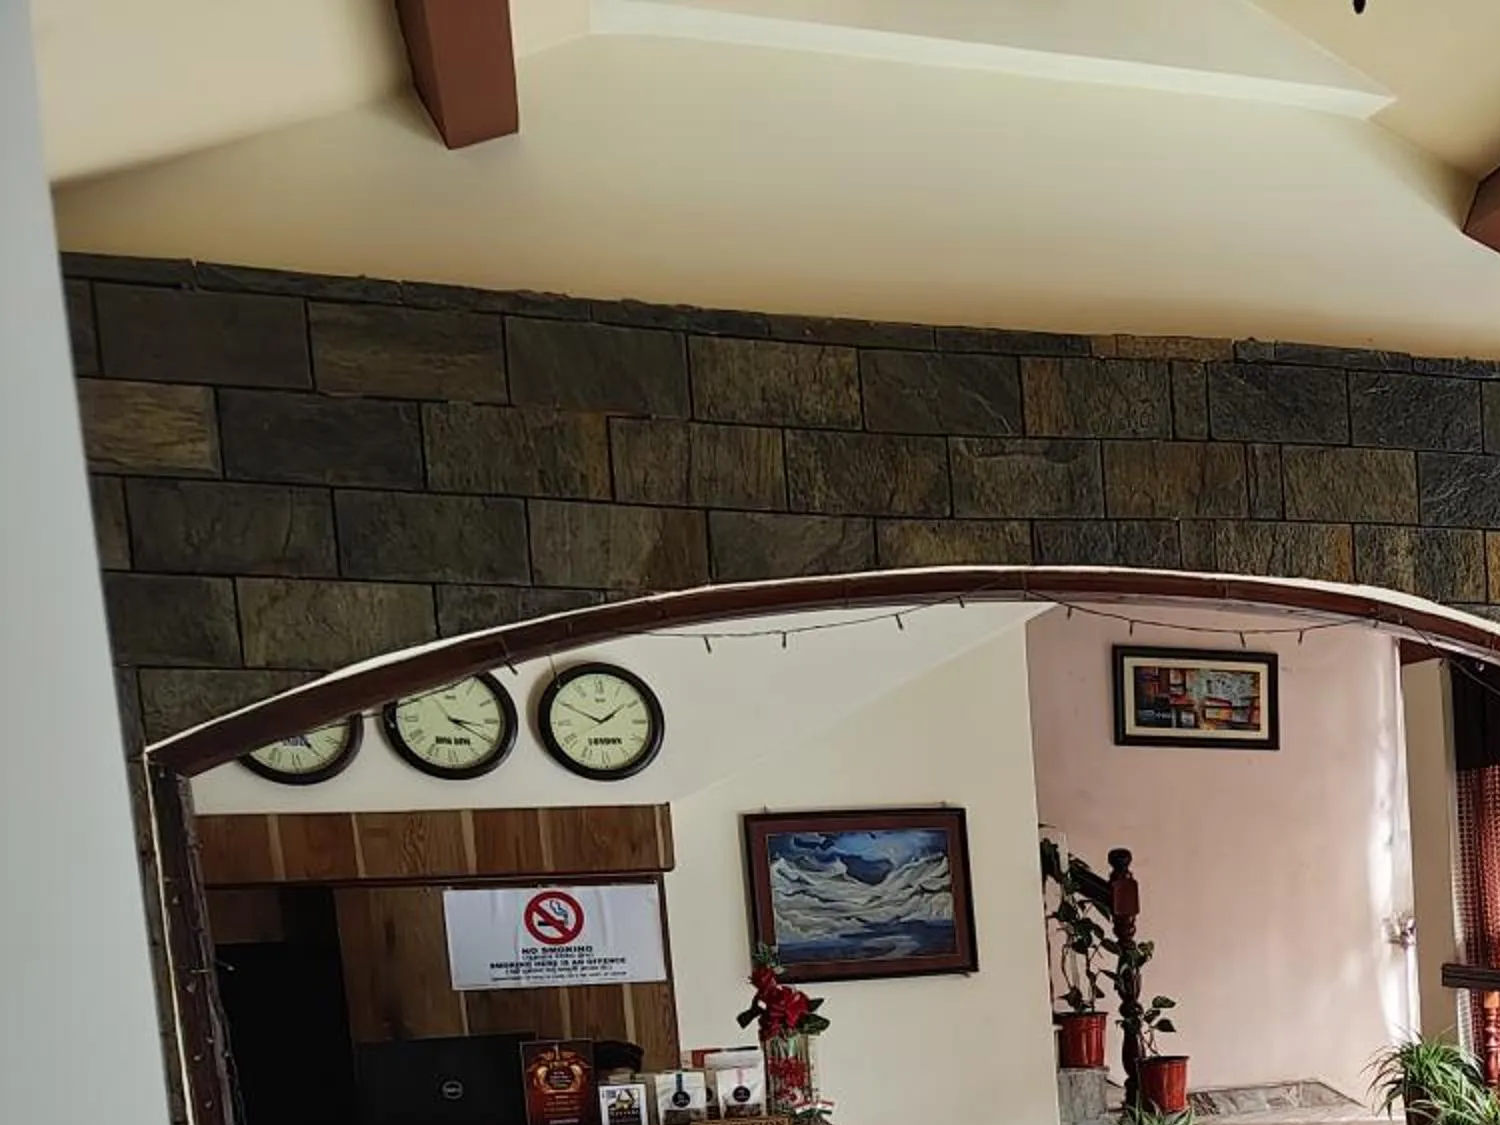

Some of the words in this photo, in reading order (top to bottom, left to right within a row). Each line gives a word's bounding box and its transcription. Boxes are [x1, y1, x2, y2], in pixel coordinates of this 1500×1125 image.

[521, 947, 538, 955] NO
[541, 945, 593, 954] SMOKING
[572, 958, 585, 966] AN
